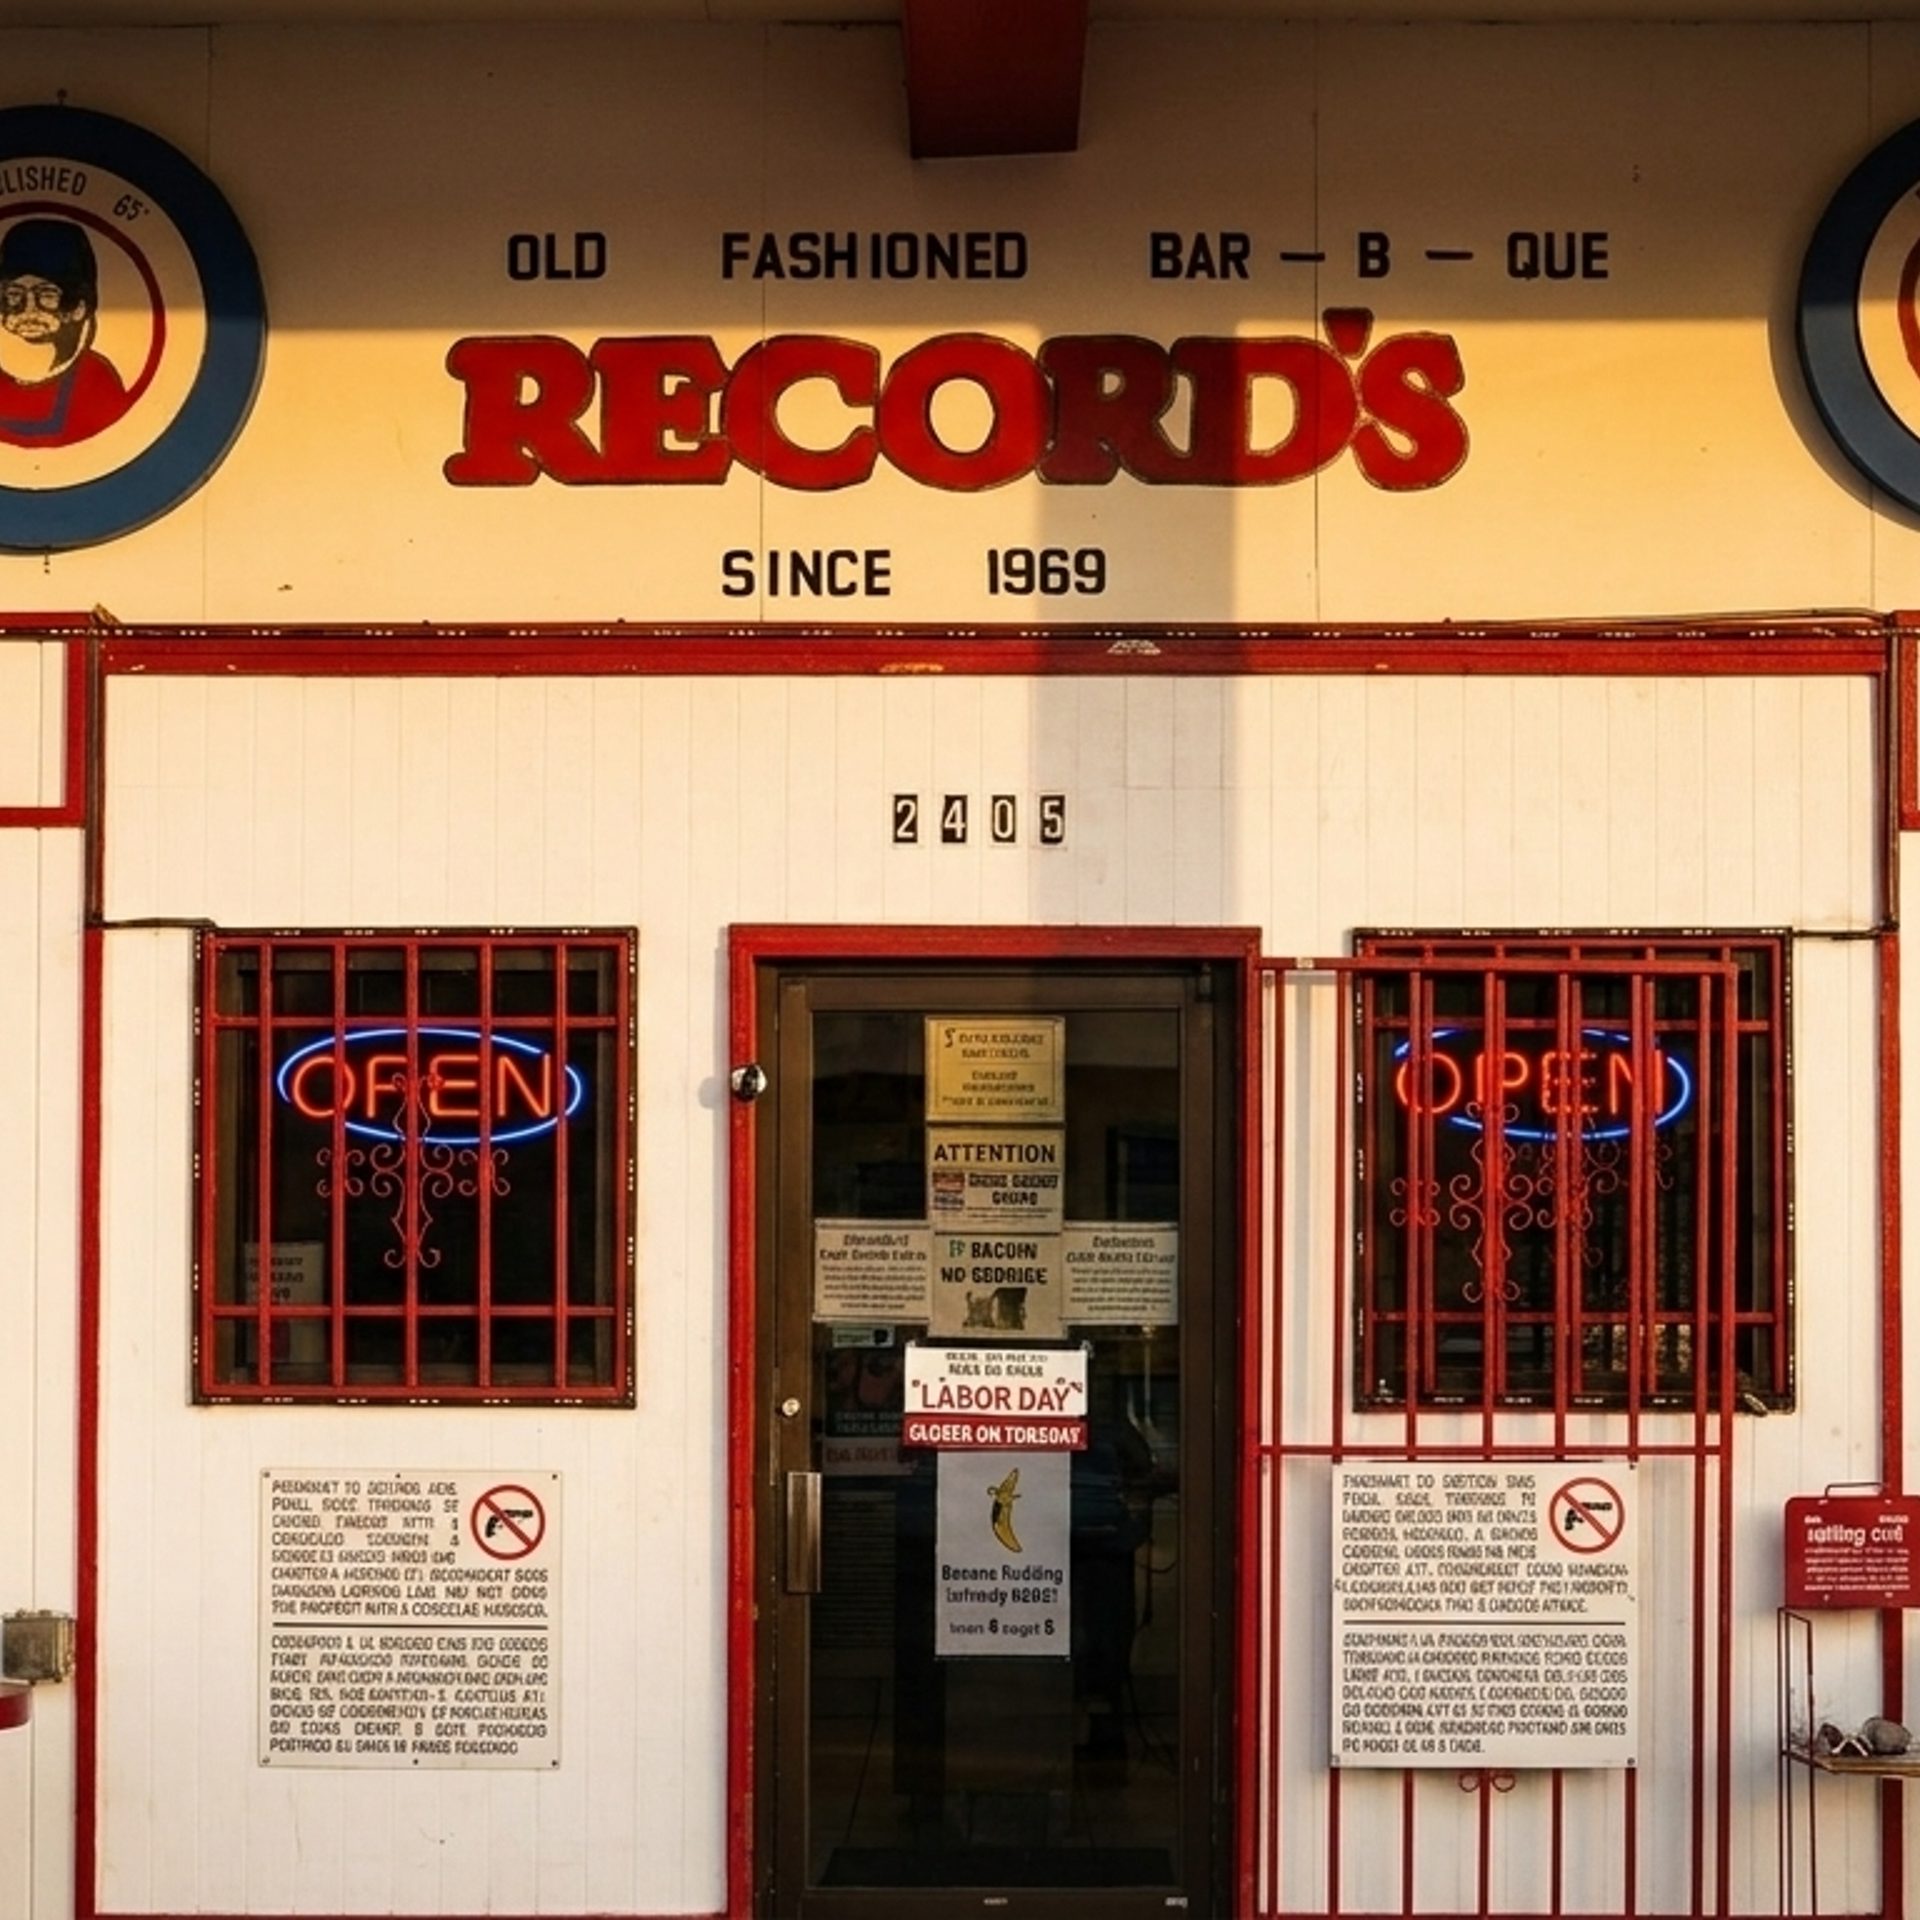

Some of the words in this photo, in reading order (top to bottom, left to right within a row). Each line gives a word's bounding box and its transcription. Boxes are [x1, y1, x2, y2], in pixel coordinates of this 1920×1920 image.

[507, 231, 607, 280] OLD
[721, 231, 1028, 279] FASHIONED
[1150, 231, 1251, 279] BAR
[1357, 231, 1390, 279] B
[1506, 231, 1609, 280] QUE
[443, 307, 1470, 491] RECORD'S
[721, 549, 891, 597] SINCE
[987, 548, 1106, 596] 1969
[893, 794, 1066, 844] 2405
[292, 1053, 550, 1118] OPEN
[1396, 1049, 1662, 1115] OPEN
[933, 1143, 1056, 1163] ATTENTION
[921, 1383, 1012, 1412] LABOR
[1018, 1385, 1070, 1412] DAY
